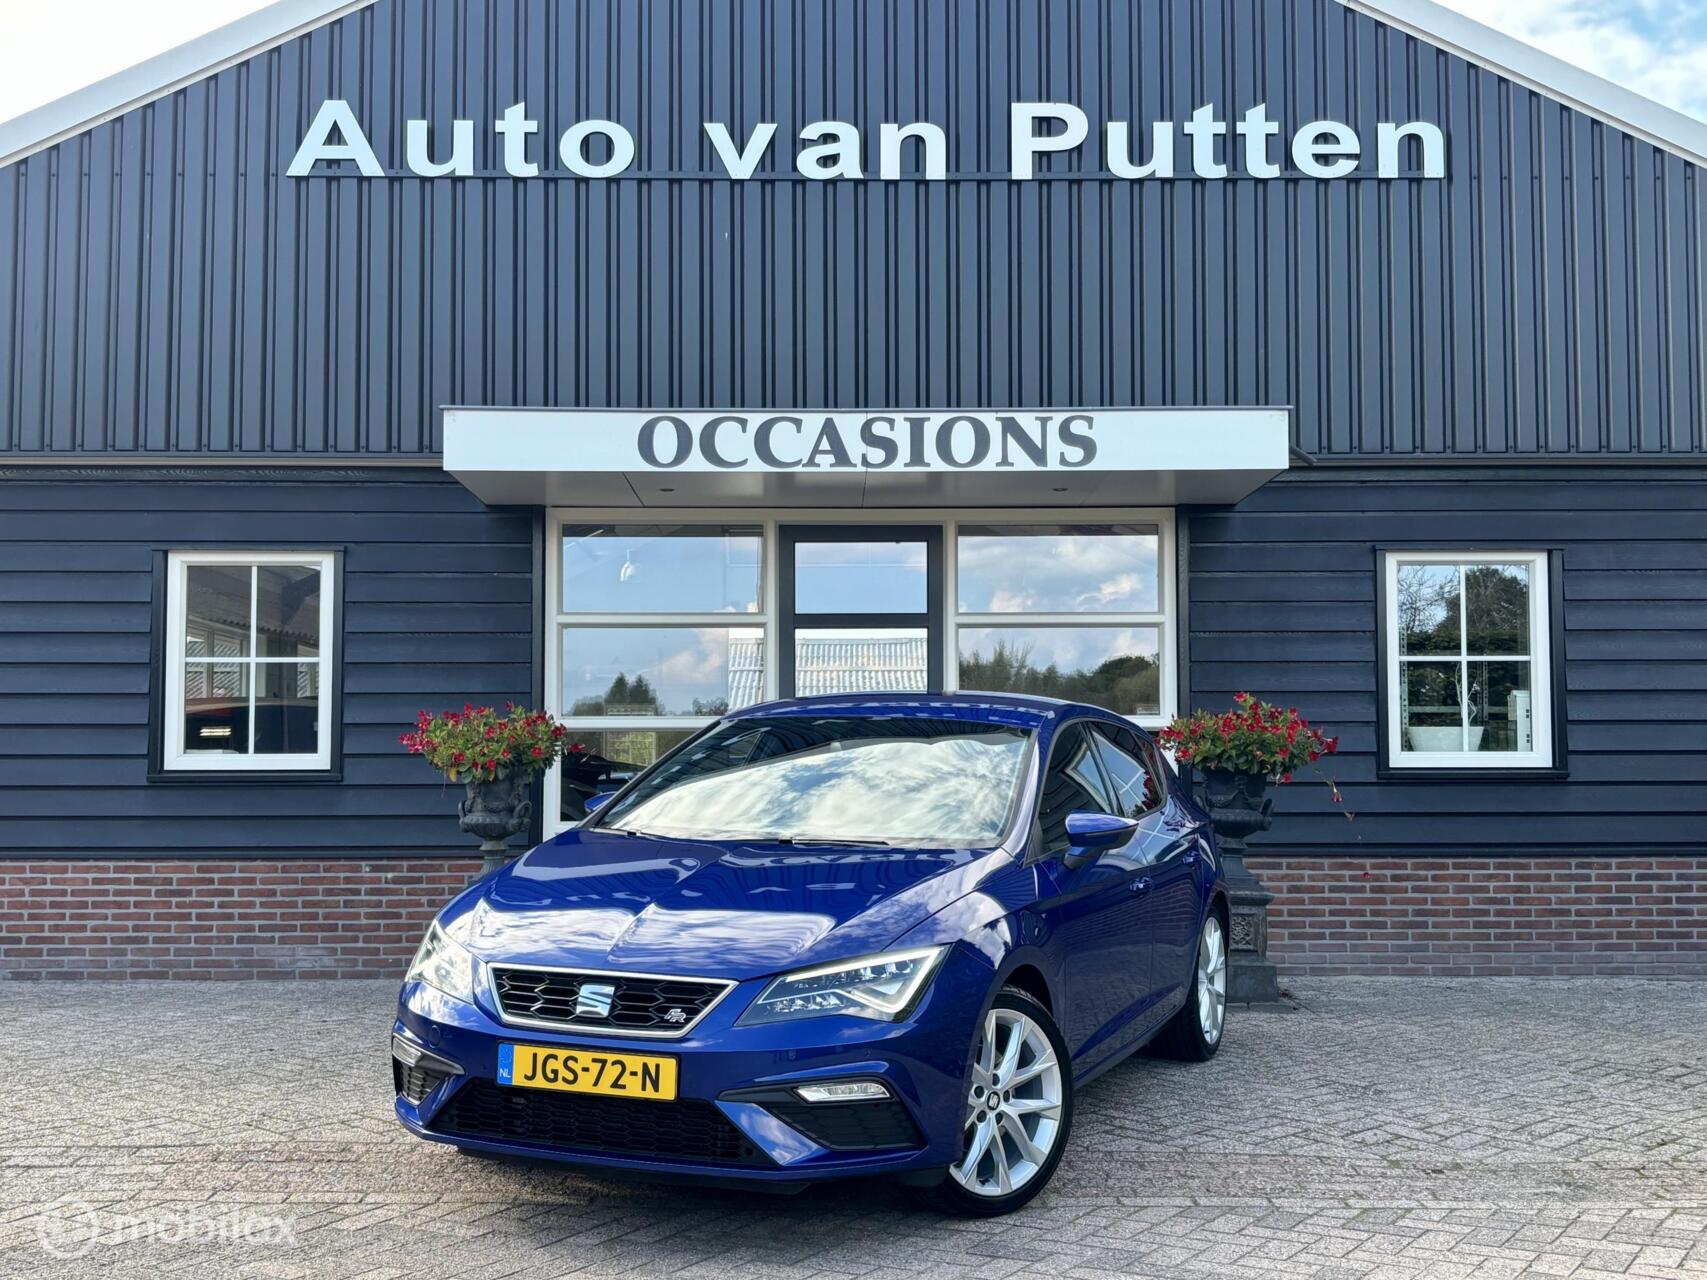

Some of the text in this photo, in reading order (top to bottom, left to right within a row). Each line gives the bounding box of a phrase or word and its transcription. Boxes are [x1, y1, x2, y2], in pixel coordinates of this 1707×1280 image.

[286, 100, 1444, 179] Auto van Putten
[638, 415, 1097, 468] OCCASIONS
[500, 1068, 511, 1078] NL
[524, 1053, 660, 1092] JGS-72-N
